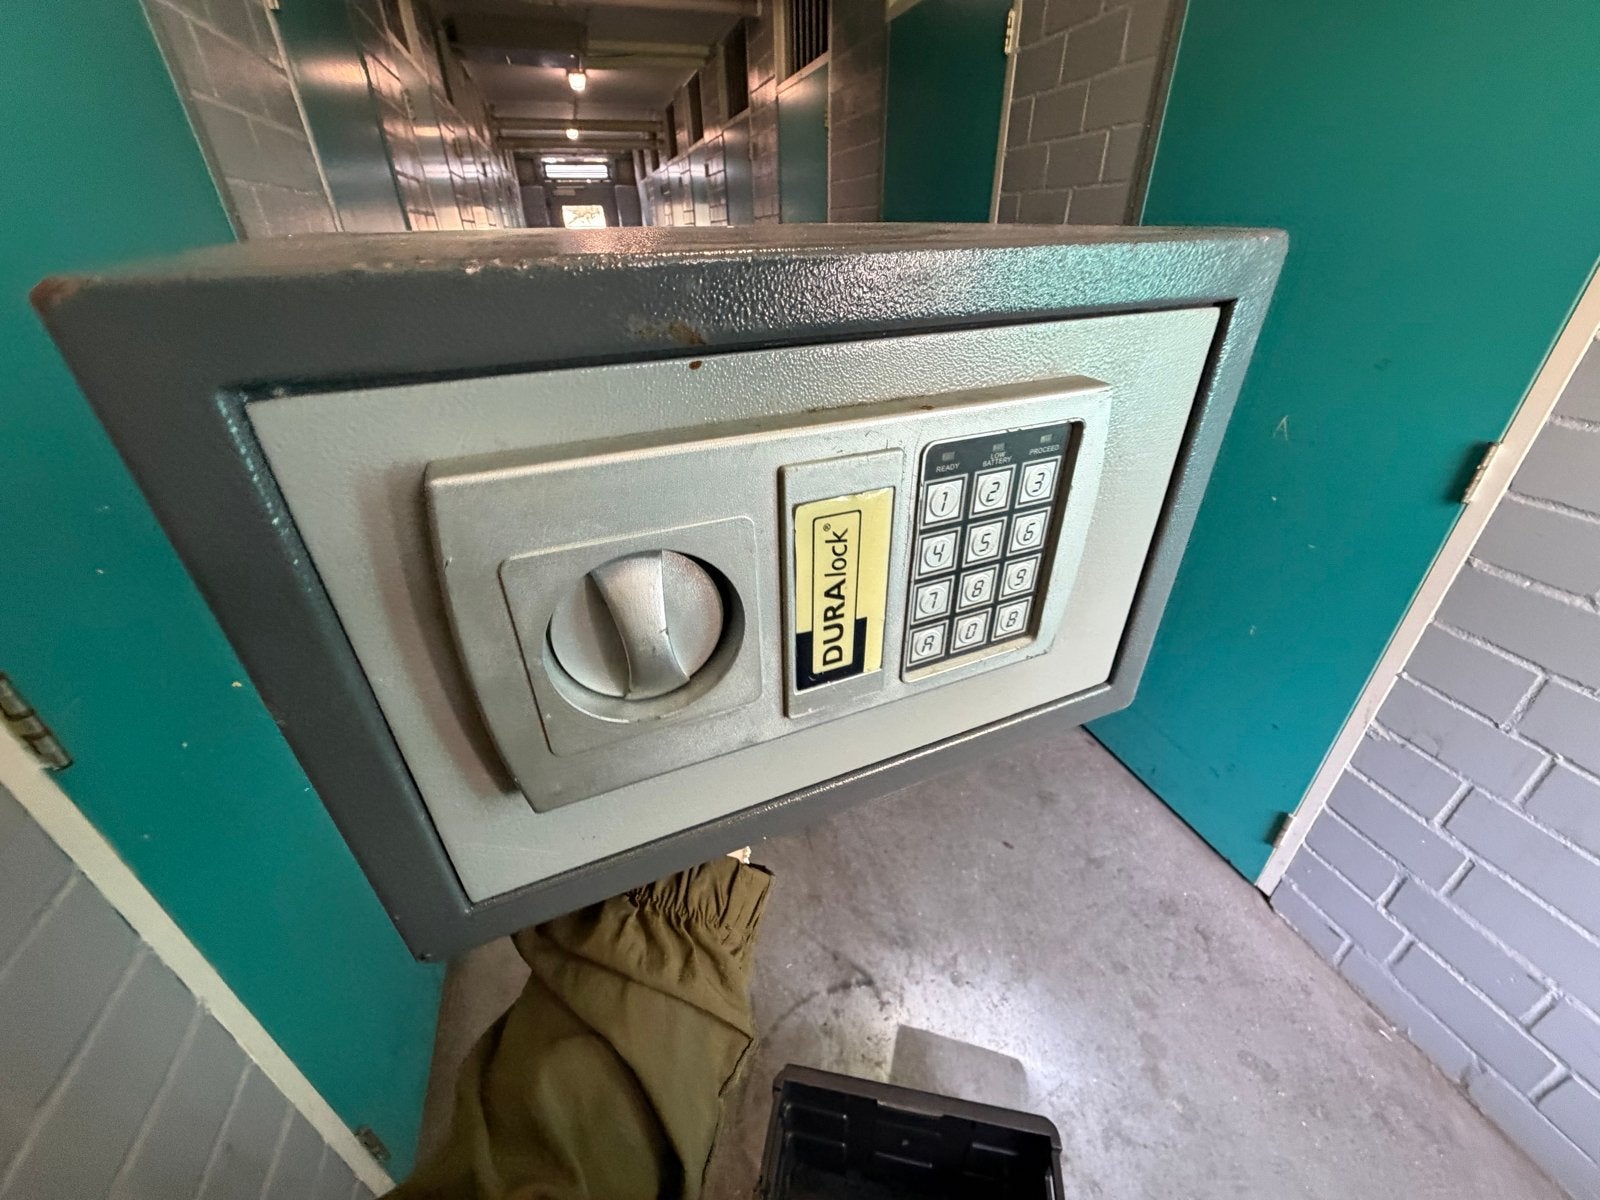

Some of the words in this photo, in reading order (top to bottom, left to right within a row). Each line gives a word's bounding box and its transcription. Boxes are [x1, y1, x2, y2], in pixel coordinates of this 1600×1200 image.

[990, 451, 1006, 460] LOW
[1029, 444, 1060, 455] PROCEED
[936, 463, 960, 473] READY
[982, 456, 1012, 467] BATTERY
[940, 492, 948, 512] 1
[985, 481, 1000, 502] 2
[1031, 472, 1045, 493] 3
[933, 543, 945, 562] 4
[979, 532, 991, 552] 5
[1023, 522, 1035, 542] 6
[929, 592, 938, 609] 7
[971, 580, 984, 598] 8
[1015, 569, 1027, 586] 9
[921, 635, 934, 652] A
